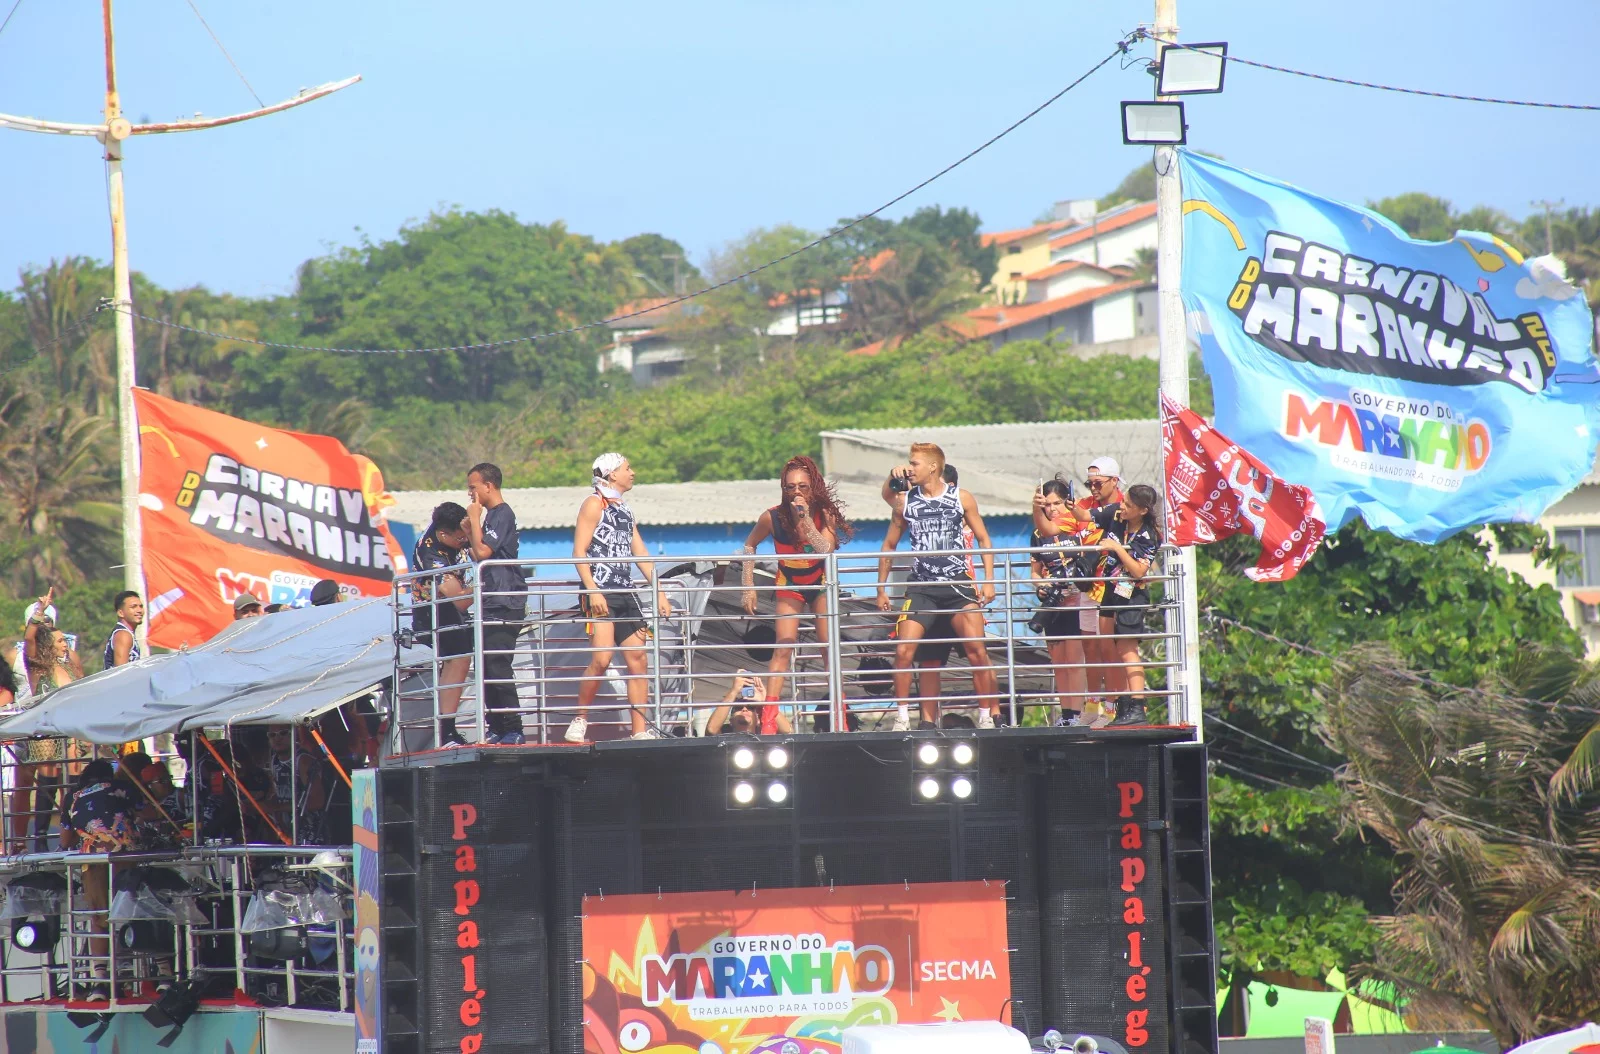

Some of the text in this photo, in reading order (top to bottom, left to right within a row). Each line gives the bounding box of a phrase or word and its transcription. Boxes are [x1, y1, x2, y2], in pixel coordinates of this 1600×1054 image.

[1229, 260, 1261, 310] DO
[1264, 232, 1521, 342] CARNAVAL
[1244, 283, 1544, 394] MARANHÃO
[1352, 392, 1452, 419] GOVERNO DO
[176, 471, 200, 507] DO
[1335, 454, 1403, 476] TRABALHANDO
[1431, 475, 1461, 488] TODOS
[204, 454, 378, 528] CARNAV
[713, 937, 822, 954] GOVERNO DO
[646, 945, 891, 1002] MARANHÃO
[920, 959, 996, 982] SECMA
[692, 1001, 849, 1016] TRABALHANDO PARA TODOS
